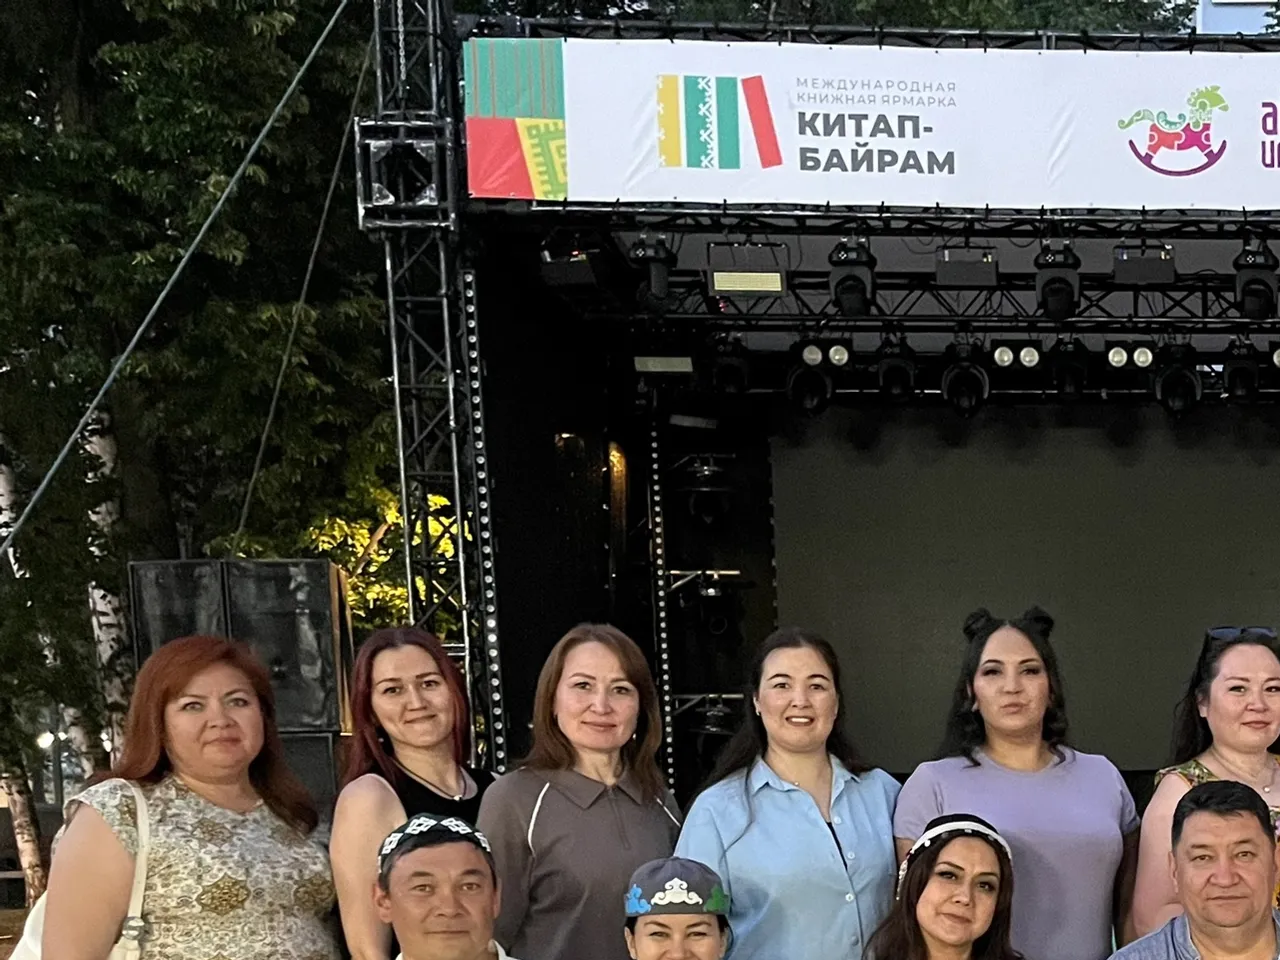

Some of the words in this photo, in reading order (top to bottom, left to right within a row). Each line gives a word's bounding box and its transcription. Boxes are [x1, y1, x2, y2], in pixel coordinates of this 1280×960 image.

[796, 77, 956, 92] МЕЖДУНАРОДНАЯ
[797, 92, 876, 105] КНИЖНАЯ
[881, 94, 957, 107] ЯРМАРКА
[798, 111, 934, 139] КИТАП-
[799, 141, 956, 175] БАЙРАМ
